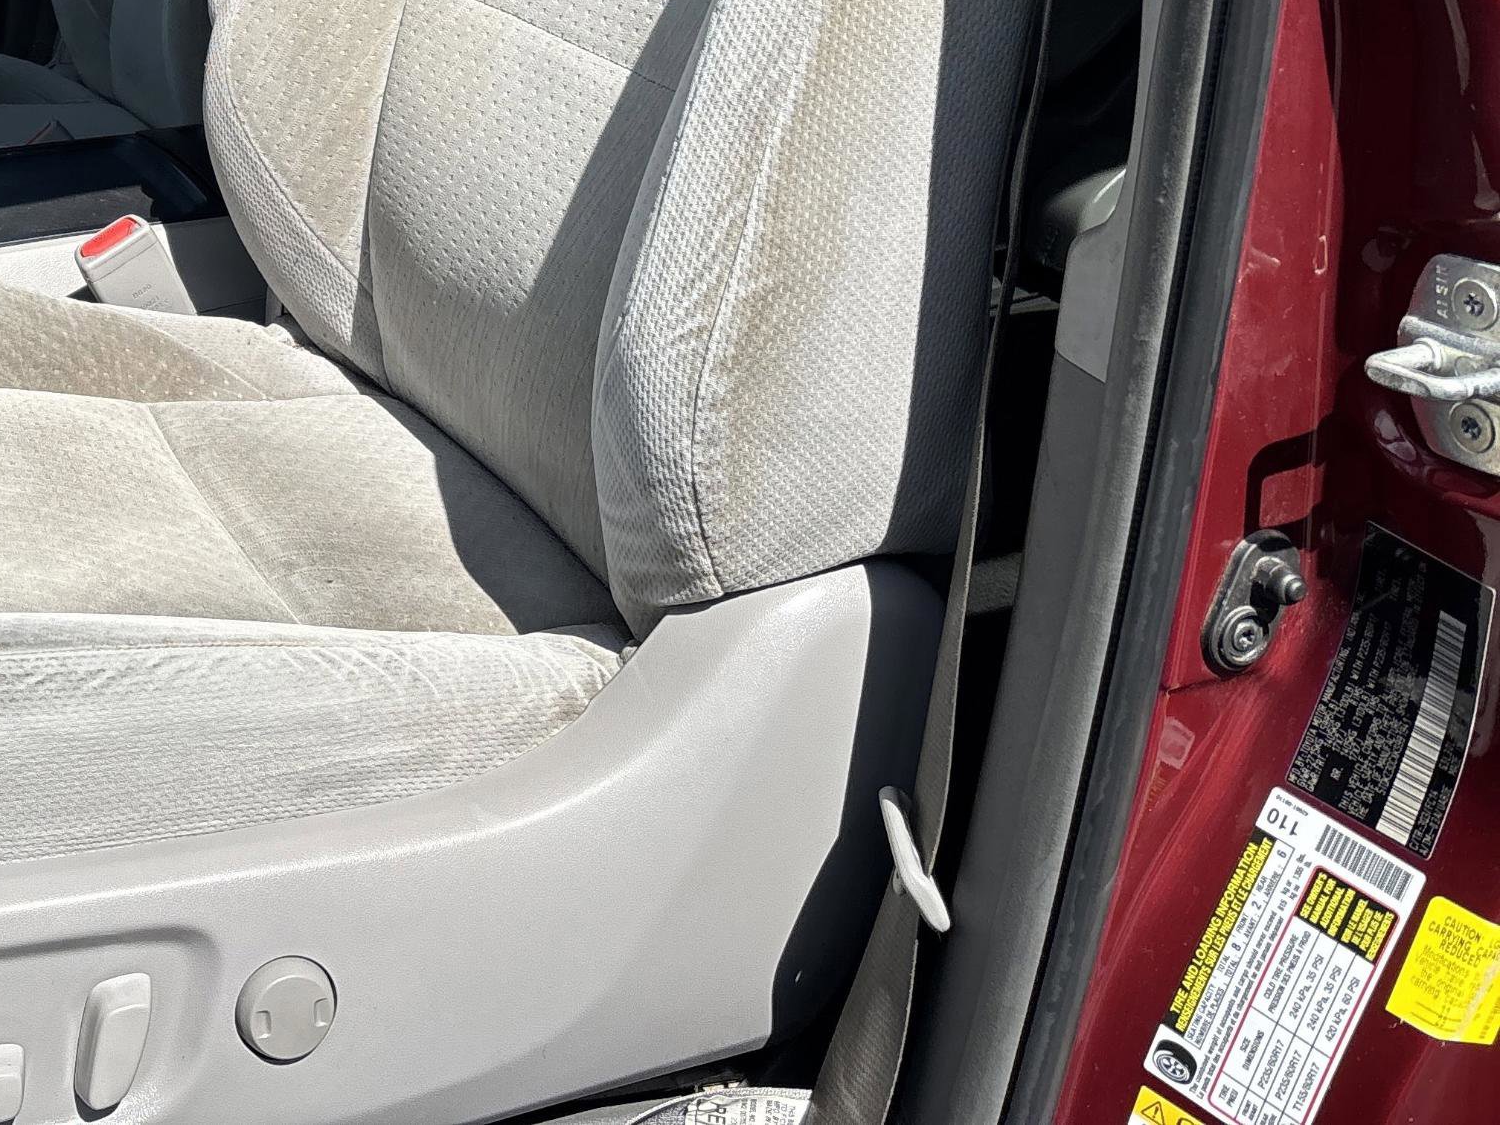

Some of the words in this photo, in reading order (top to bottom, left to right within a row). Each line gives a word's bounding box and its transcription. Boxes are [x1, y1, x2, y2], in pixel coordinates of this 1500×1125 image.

[1372, 733, 1385, 750] AND
[1338, 790, 1353, 809] THIS
[1265, 806, 1301, 837] 110
[1241, 836, 1273, 890] CHARGEMENT
[1276, 849, 1286, 858] 6
[1236, 888, 1248, 901] LE
[1255, 875, 1267, 892] REAR
[1305, 871, 1327, 905] OWNER'S
[1231, 898, 1242, 911] ET
[1250, 900, 1261, 910] 2
[1299, 902, 1312, 918] SEE
[1309, 893, 1328, 924] MANUAL
[1323, 877, 1336, 894] FOR
[1318, 885, 1344, 929] ADDITIONAL
[1327, 887, 1355, 937] INFORMATION
[1169, 987, 1188, 1014] TIRE
[1180, 963, 1199, 990] AND
[1191, 915, 1222, 966] LOADING
[1215, 841, 1258, 917] INFORMATION
[1218, 909, 1237, 936] PNEUS
[1235, 912, 1249, 933] FRONT
[1427, 919, 1472, 953] CARRYING
[1204, 949, 1218, 967] SUR
[1211, 934, 1225, 951] LES
[1230, 942, 1241, 951] 8
[1439, 937, 1481, 969] REDUCED
[1216, 953, 1229, 972] TOTAL
[1263, 981, 1276, 999] COLD
[1271, 966, 1282, 981] TIRE
[1278, 933, 1298, 967] PRESSURE
[1267, 984, 1285, 1014] PRESSION
[1280, 972, 1291, 985] DES
[1286, 953, 1299, 974] PNEUS
[1297, 929, 1311, 949] FROID
[1175, 964, 1211, 1032] RENSEIGNEMENTS
[1288, 1001, 1301, 1019] 240
[1296, 982, 1311, 1002] kPa,
[1305, 969, 1316, 983] 35
[1311, 953, 1324, 970] PSI
[1306, 1012, 1319, 1030] 240
[1314, 993, 1329, 1014] kPa,
[1323, 981, 1334, 994] 35
[1329, 964, 1342, 982] PSI
[1186, 1013, 1202, 1040] SEATING
[1198, 983, 1216, 1013] CAPACITY
[1193, 1018, 1210, 1045] NOMBRE
[1205, 1010, 1213, 1018] DE
[1209, 986, 1224, 1009] PLACES
[1324, 1024, 1337, 1042] 420
[1332, 1005, 1347, 1025] kPa,
[1341, 992, 1352, 1005] 60
[1347, 976, 1360, 993] PSI
[1239, 1036, 1251, 1052] SIZE
[1241, 1029, 1265, 1070] DIMENSIONS
[1256, 1039, 1286, 1089] P235/60R17
[1273, 1049, 1303, 1100] P235/60R17
[1218, 1084, 1230, 1100] TIRE
[1225, 1088, 1238, 1107] PNEU
